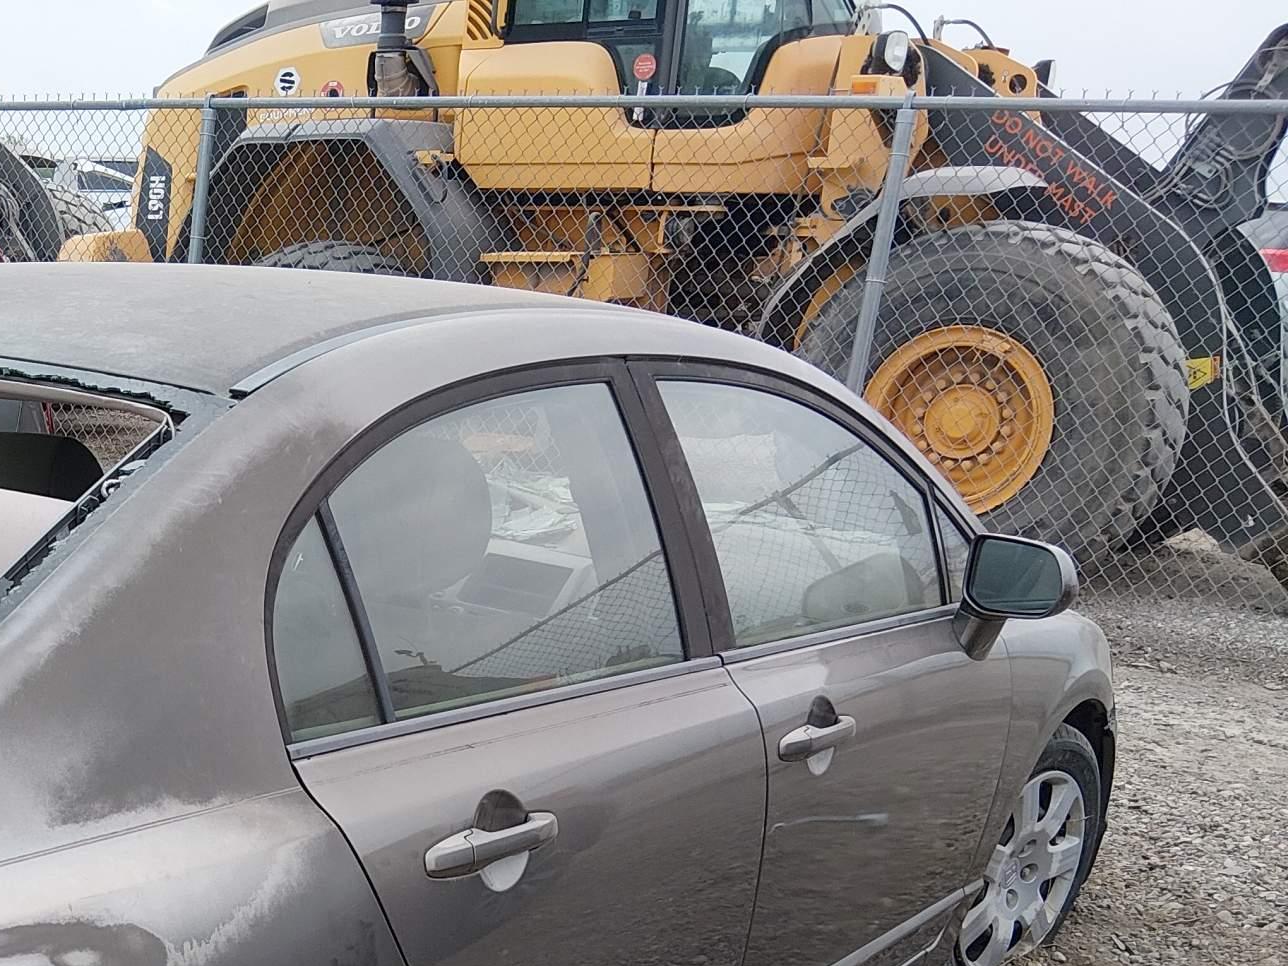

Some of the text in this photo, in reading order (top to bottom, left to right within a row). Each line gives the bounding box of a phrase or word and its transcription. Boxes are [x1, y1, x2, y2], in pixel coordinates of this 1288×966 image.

[334, 16, 421, 38] VOLO
[991, 110, 1118, 210] DO NOT WALK
[147, 175, 167, 220] L90H
[1044, 182, 1096, 224] MAST
